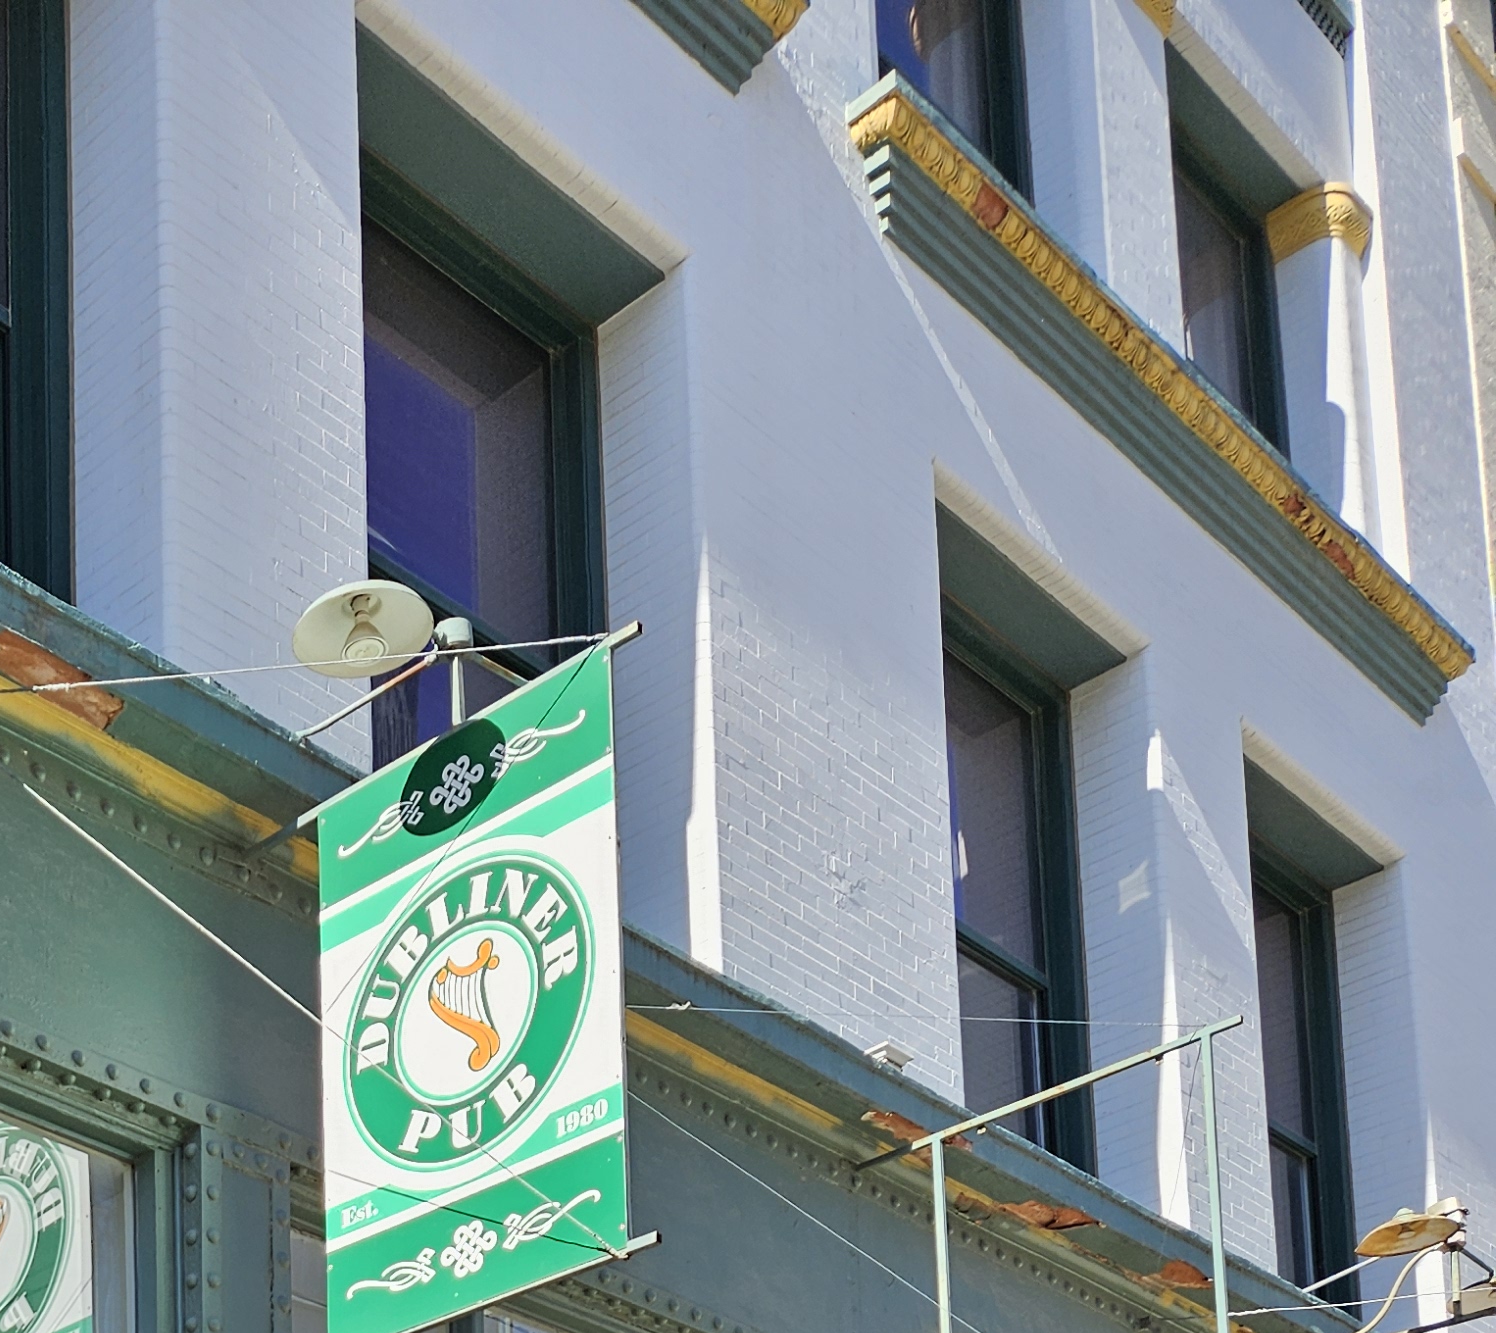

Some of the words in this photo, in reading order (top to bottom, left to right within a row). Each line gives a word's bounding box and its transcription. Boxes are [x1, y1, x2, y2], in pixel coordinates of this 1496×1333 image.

[357, 867, 580, 1075] DUBLINER
[398, 1063, 536, 1154] PUB
[555, 1098, 609, 1138] 1980
[340, 1200, 379, 1229] Est.
